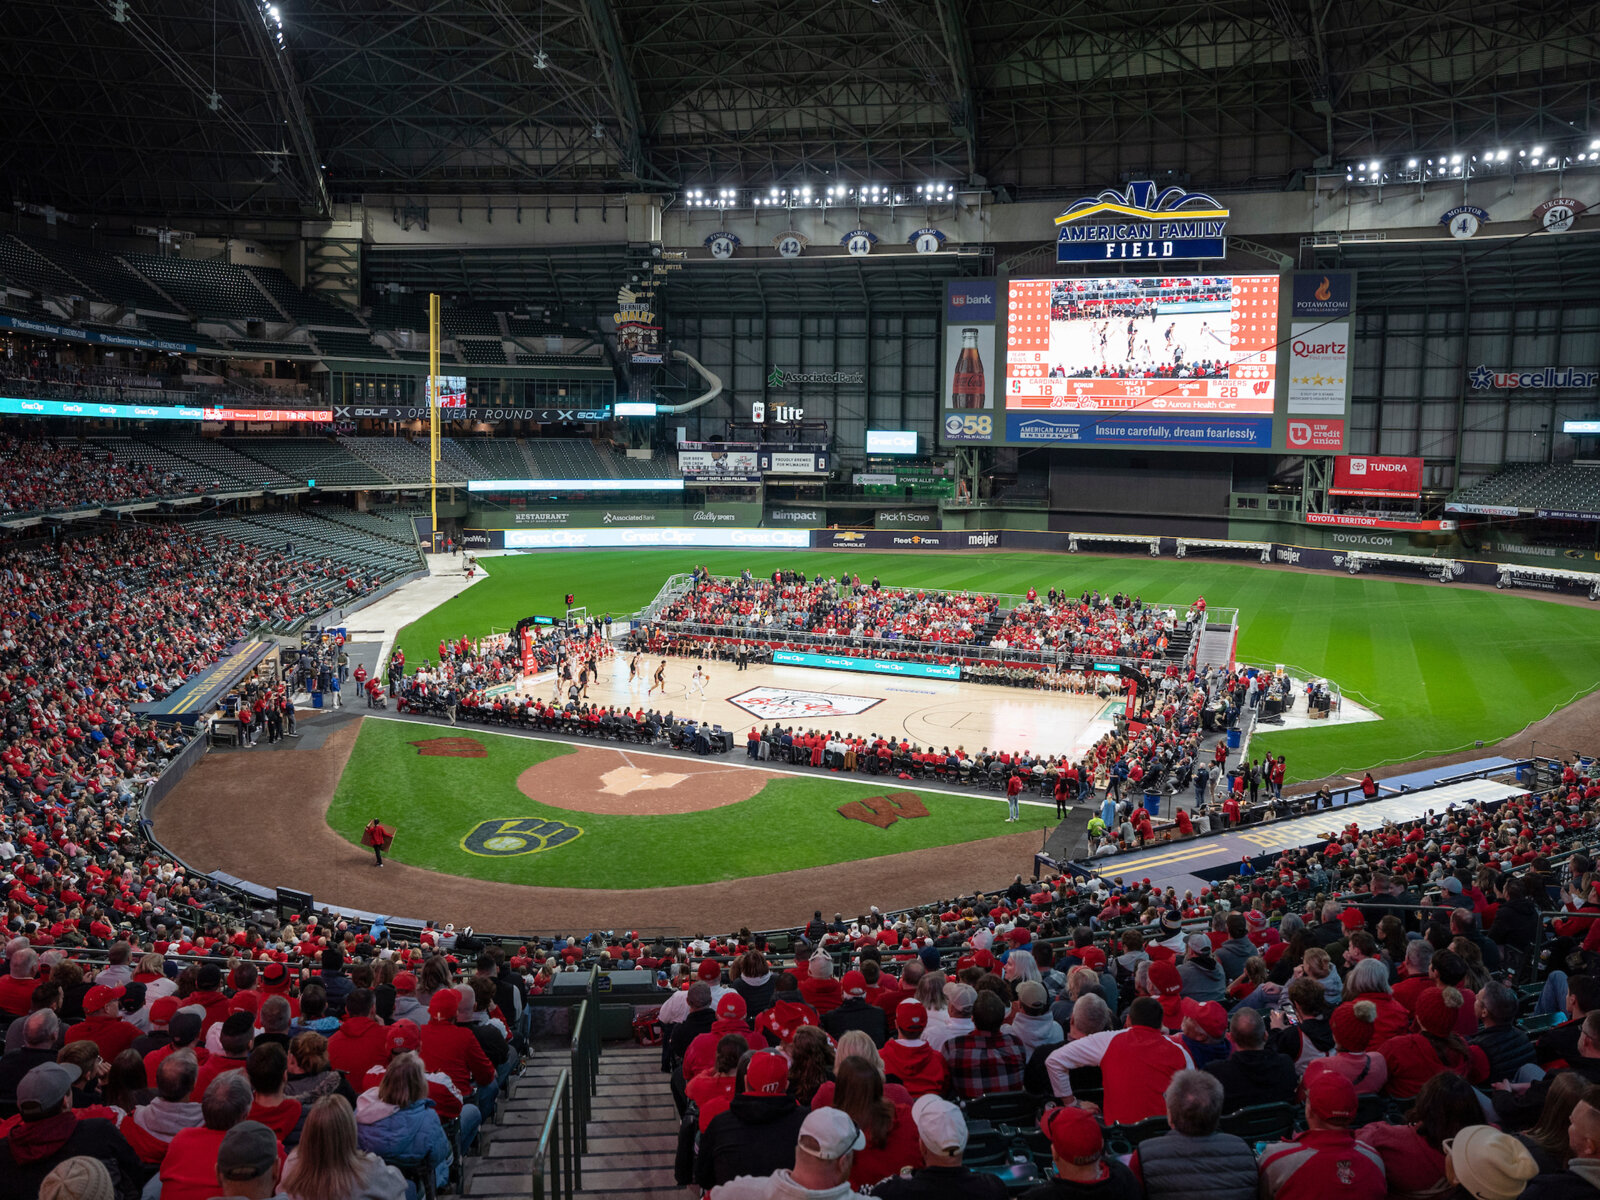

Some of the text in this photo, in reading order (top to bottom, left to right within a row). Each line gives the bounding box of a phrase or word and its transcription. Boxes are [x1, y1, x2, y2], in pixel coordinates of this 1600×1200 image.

[1542, 199, 1575, 210] UECKER
[1448, 208, 1482, 218] MOLITOR
[1549, 209, 1568, 222] 50
[1058, 222, 1226, 241] AMERICAN FAMILY
[1458, 218, 1468, 233] 4
[710, 232, 735, 241] FINGERS
[714, 242, 731, 254] 34
[782, 241, 799, 253] 42
[850, 240, 868, 252] 44
[924, 240, 932, 252] 1
[1106, 241, 1174, 258] FIELD
[952, 294, 992, 305] us bank
[620, 303, 650, 312] BERNIE'S
[614, 310, 656, 324] CHALET
[17, 320, 45, 331] Northwestern
[106, 335, 138, 346] Northwestern
[1292, 340, 1346, 358] Quartz
[1034, 353, 1040, 361] 8
[1260, 353, 1267, 362] 8
[784, 372, 864, 384] AssociatedBank
[1494, 367, 1598, 388] uscellular
[1039, 385, 1052, 395] 18
[1126, 386, 1145, 396] 1:31
[1220, 387, 1238, 398] 28
[1253, 381, 1270, 396] W
[334, 406, 351, 417] X
[408, 408, 534, 420] OPEN YEAR ROUND
[558, 410, 574, 420] X
[776, 405, 804, 424] Lite
[963, 415, 992, 435] 58
[1096, 425, 1257, 440] Insure carefully, dream fearlessly.
[1370, 463, 1408, 472] TUNDRA
[693, 511, 717, 522] Bally
[781, 511, 816, 522] impact
[907, 513, 929, 522] Save
[1308, 514, 1376, 526] TOYOTA TERRITORY
[510, 532, 587, 546] Great Clips
[622, 529, 696, 544] Great Clips
[731, 531, 806, 545] Great Clips
[969, 532, 998, 547] meijer
[1333, 533, 1393, 546] TOYOTA.COM
[1276, 548, 1300, 564] meijer
[1238, 809, 1386, 848] BREWERS
